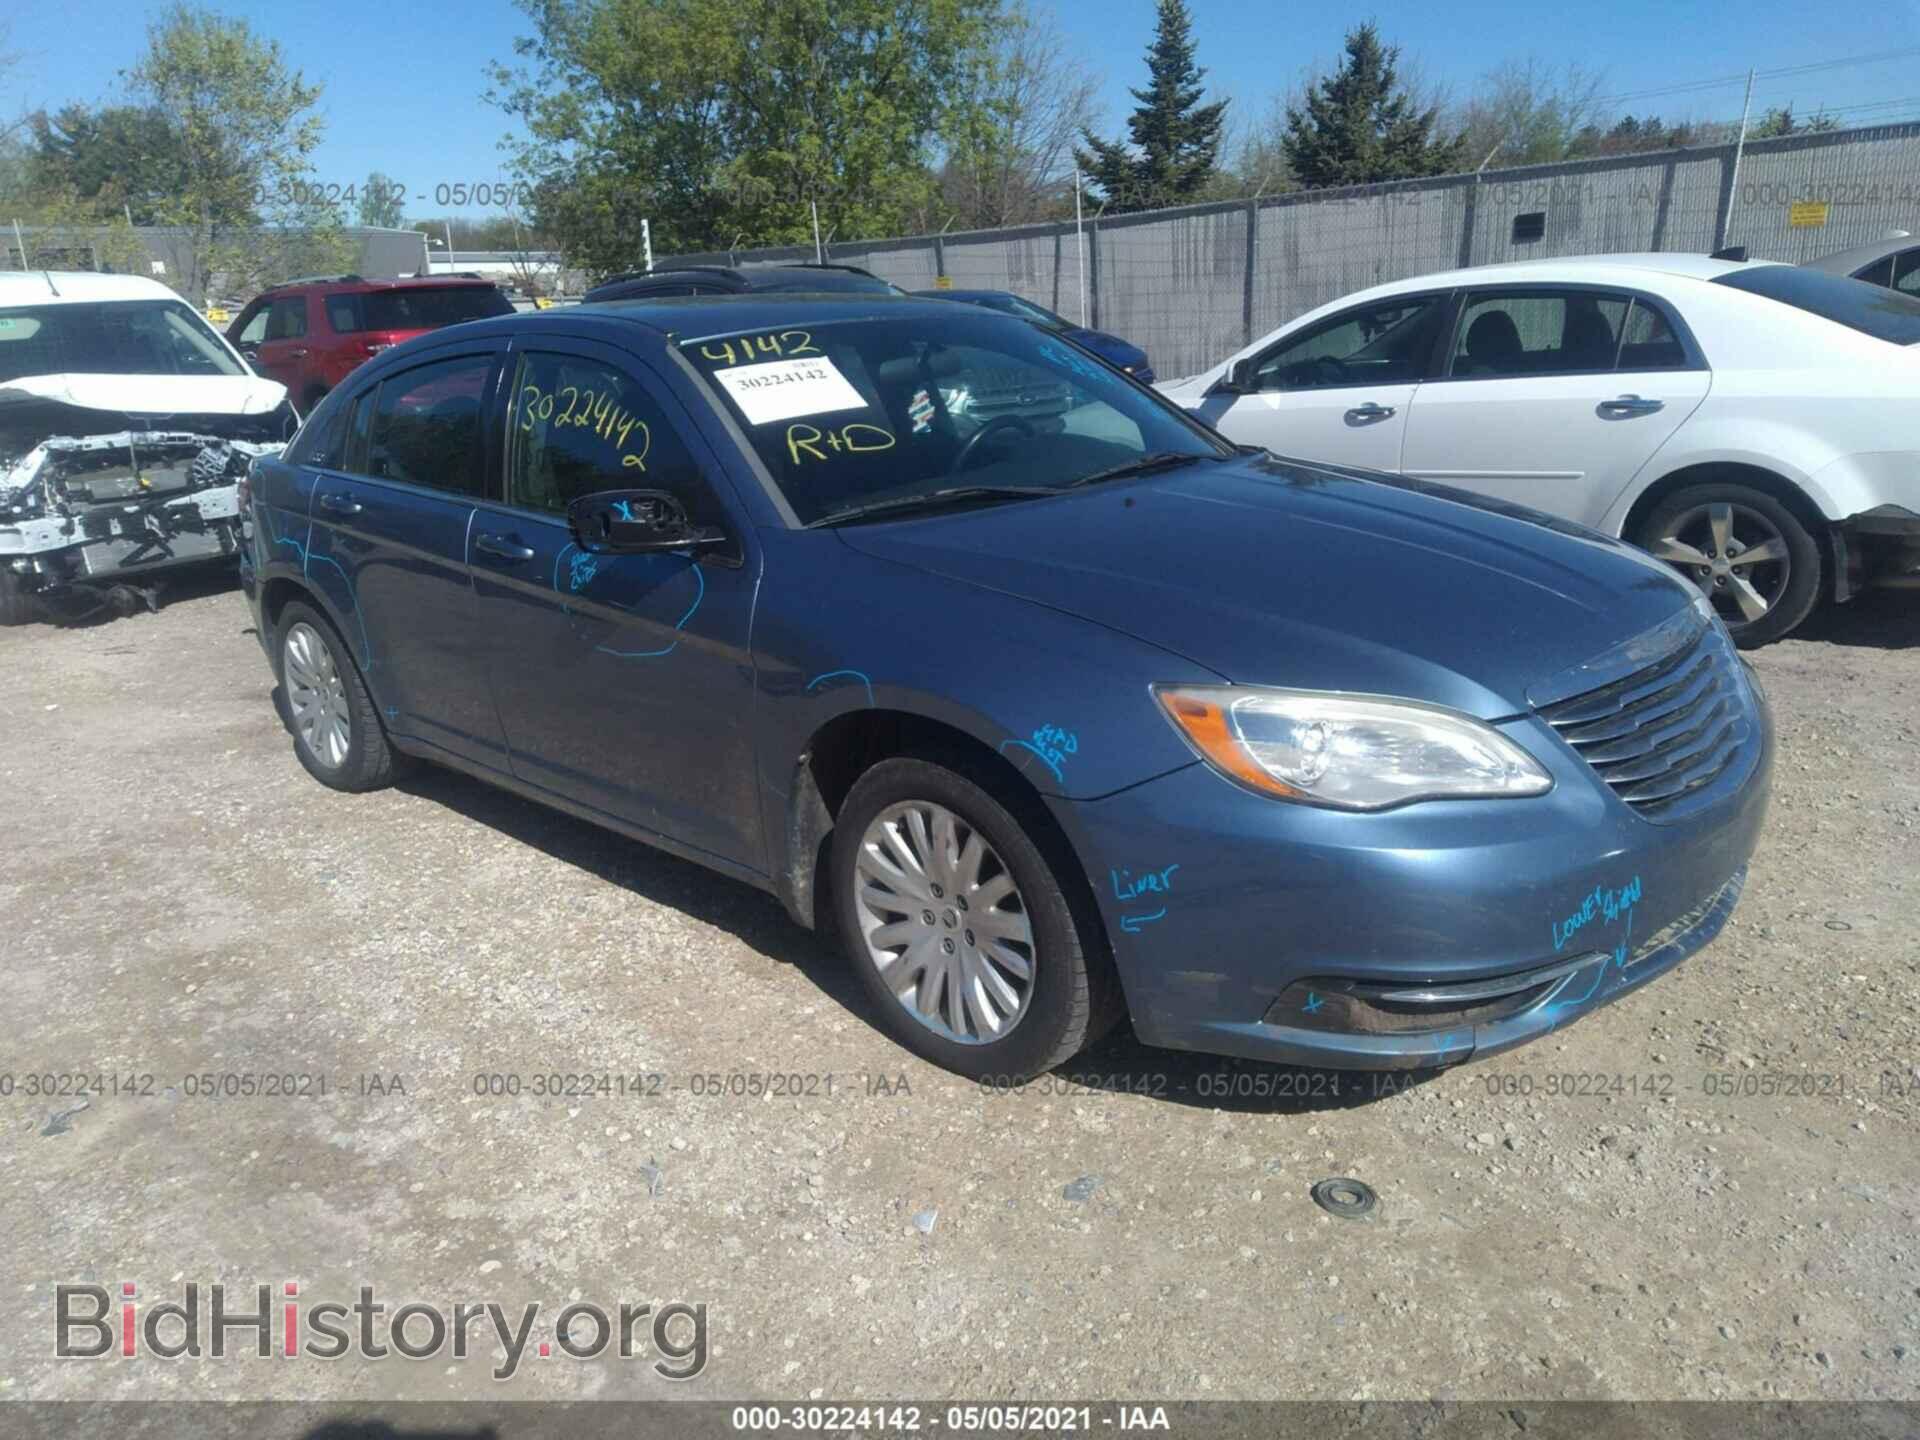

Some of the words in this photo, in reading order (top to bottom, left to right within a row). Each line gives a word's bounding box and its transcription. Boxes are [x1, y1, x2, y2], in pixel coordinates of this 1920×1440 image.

[700, 329, 821, 366] 4142
[737, 369, 828, 391] 30224142
[521, 385, 651, 473] 30224142
